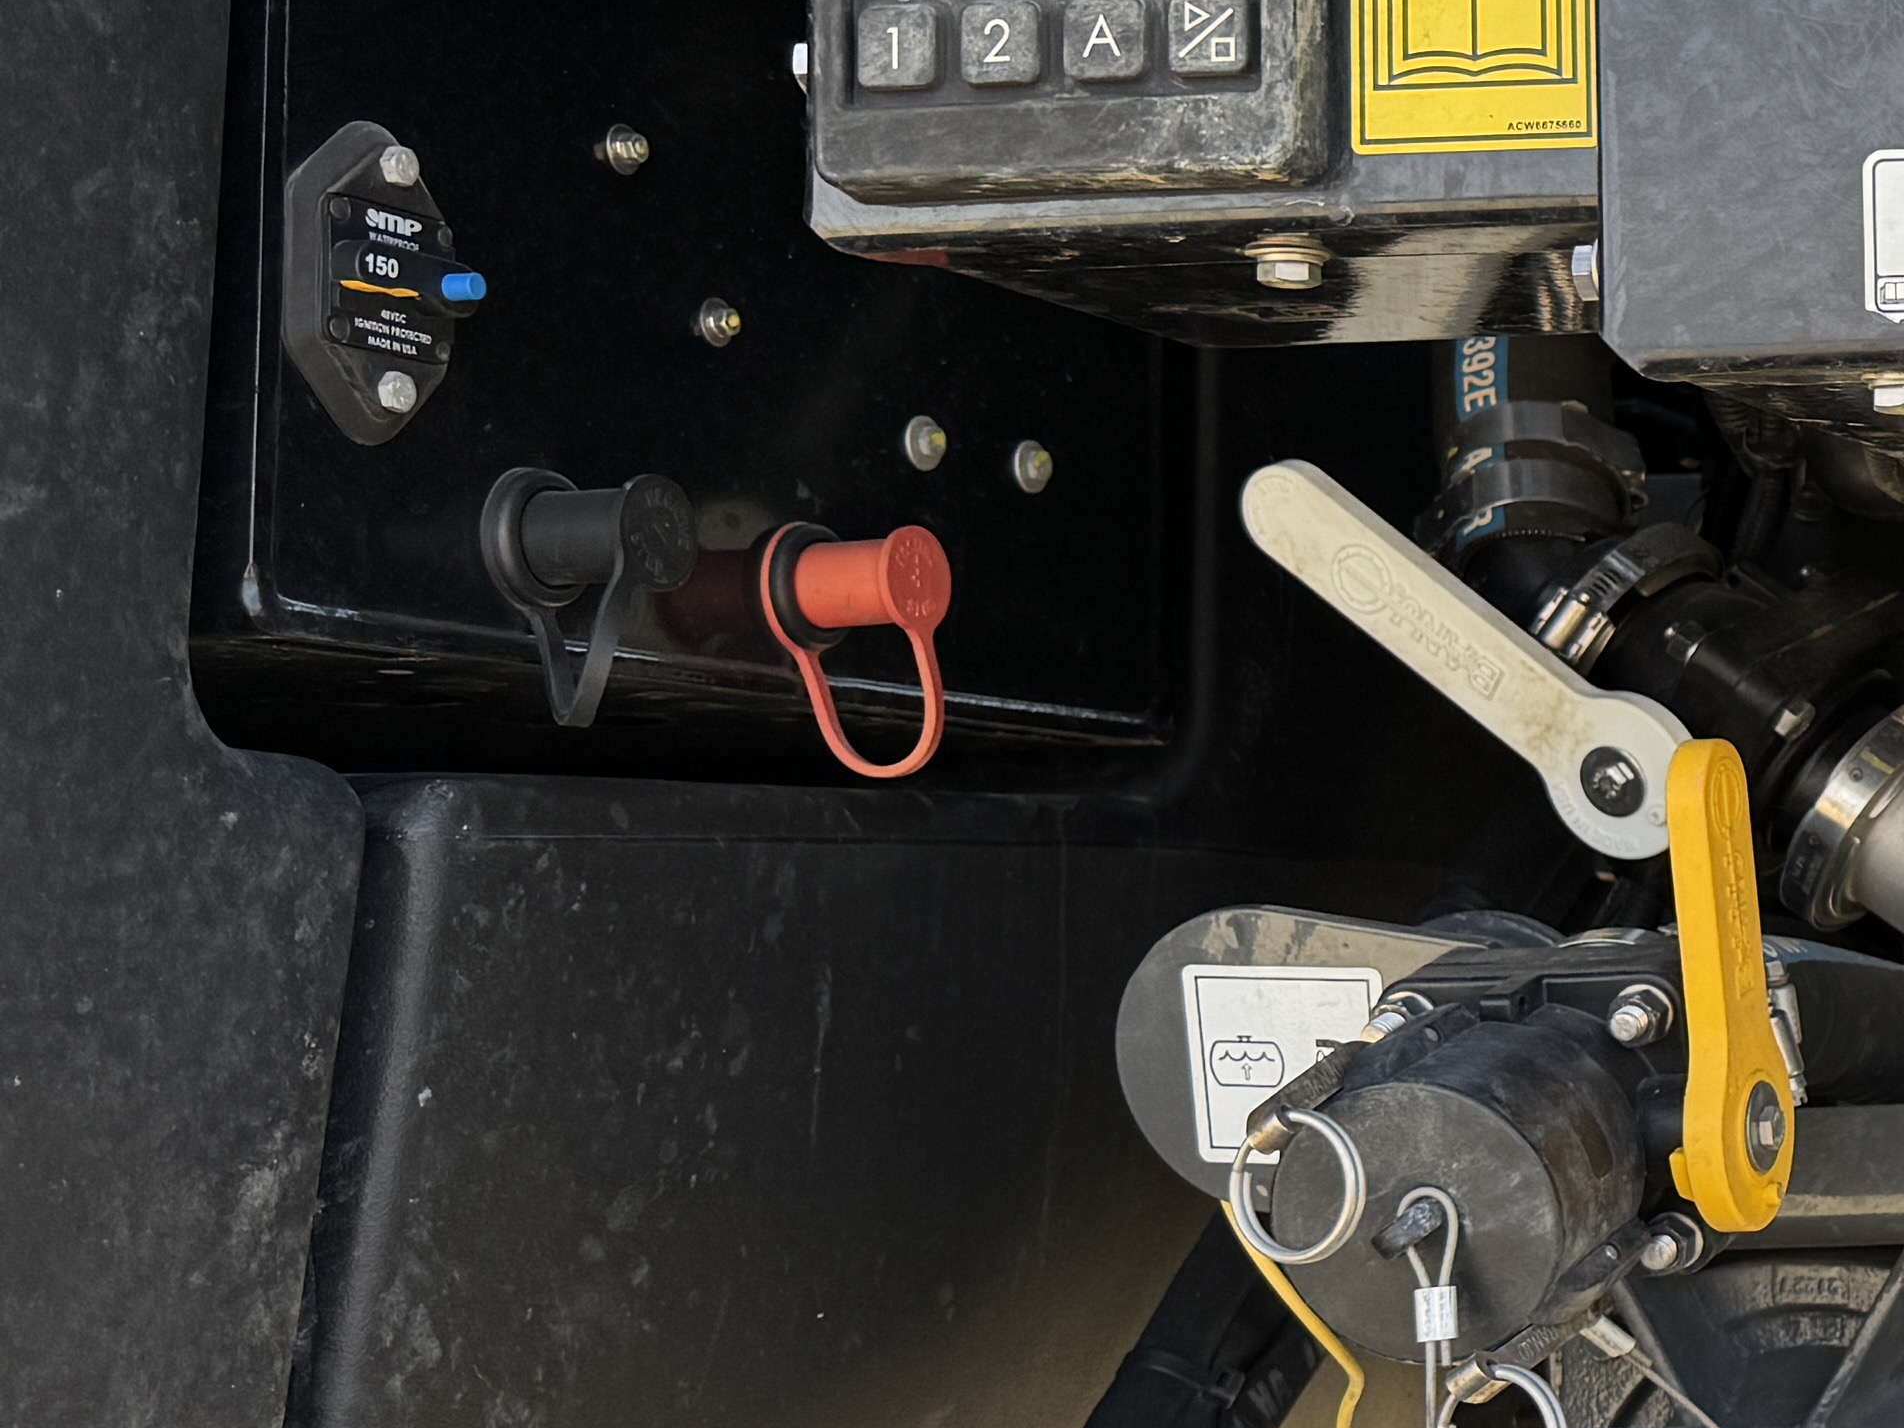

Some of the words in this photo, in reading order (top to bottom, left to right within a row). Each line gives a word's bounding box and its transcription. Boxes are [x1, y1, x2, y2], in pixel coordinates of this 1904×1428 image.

[885, 26, 900, 71] 1
[982, 18, 1012, 64] 2
[1081, 13, 1122, 59] A
[365, 253, 400, 279] 150
